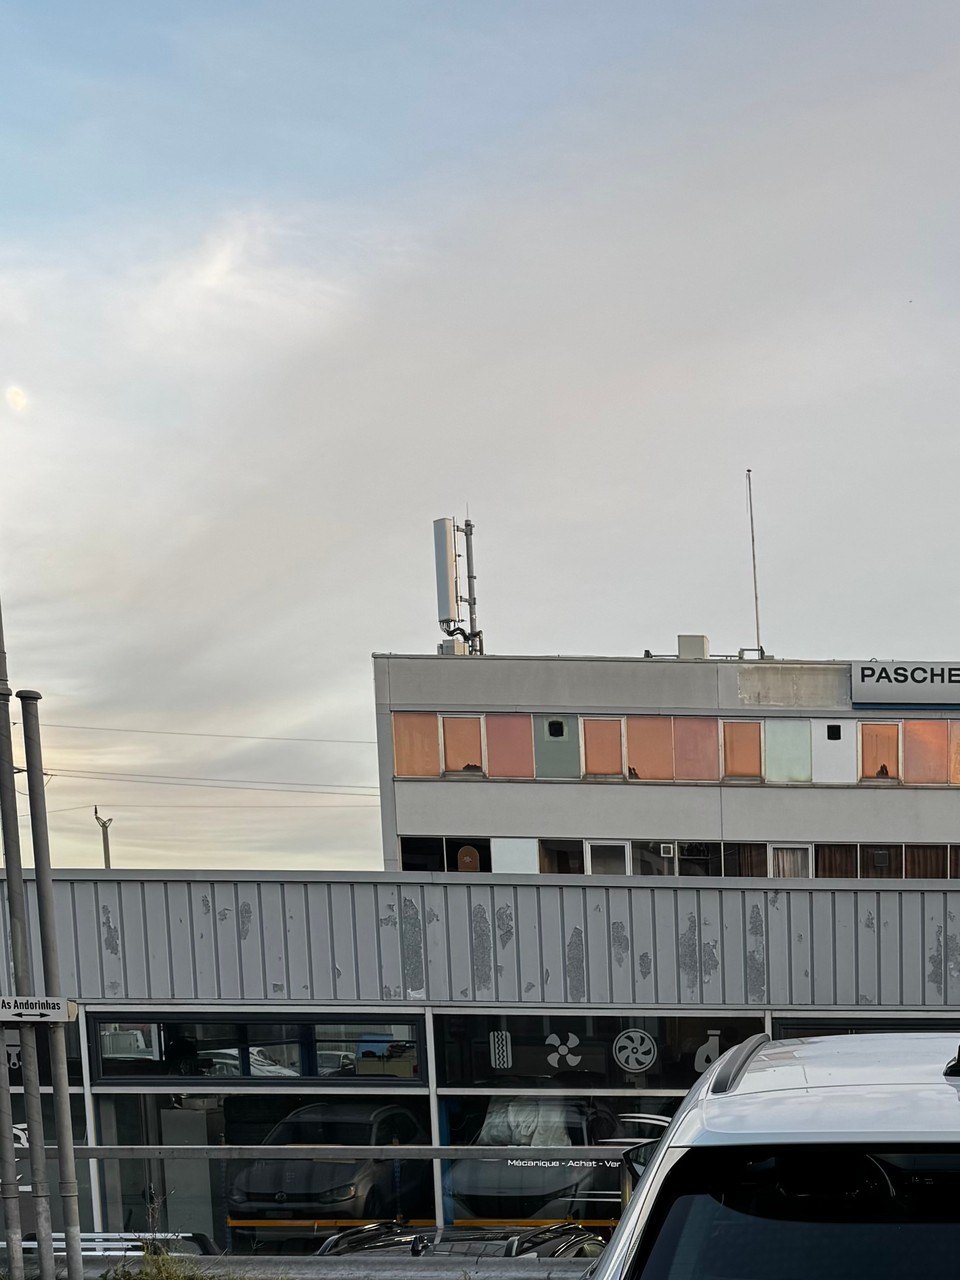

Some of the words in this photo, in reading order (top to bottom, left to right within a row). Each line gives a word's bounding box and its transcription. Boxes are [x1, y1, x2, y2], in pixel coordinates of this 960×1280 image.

[1, 999, 12, 1010] As
[13, 999, 61, 1010] Andorinhas
[507, 1159, 560, 1168] Mécanique
[567, 1160, 597, 1168] Achat
